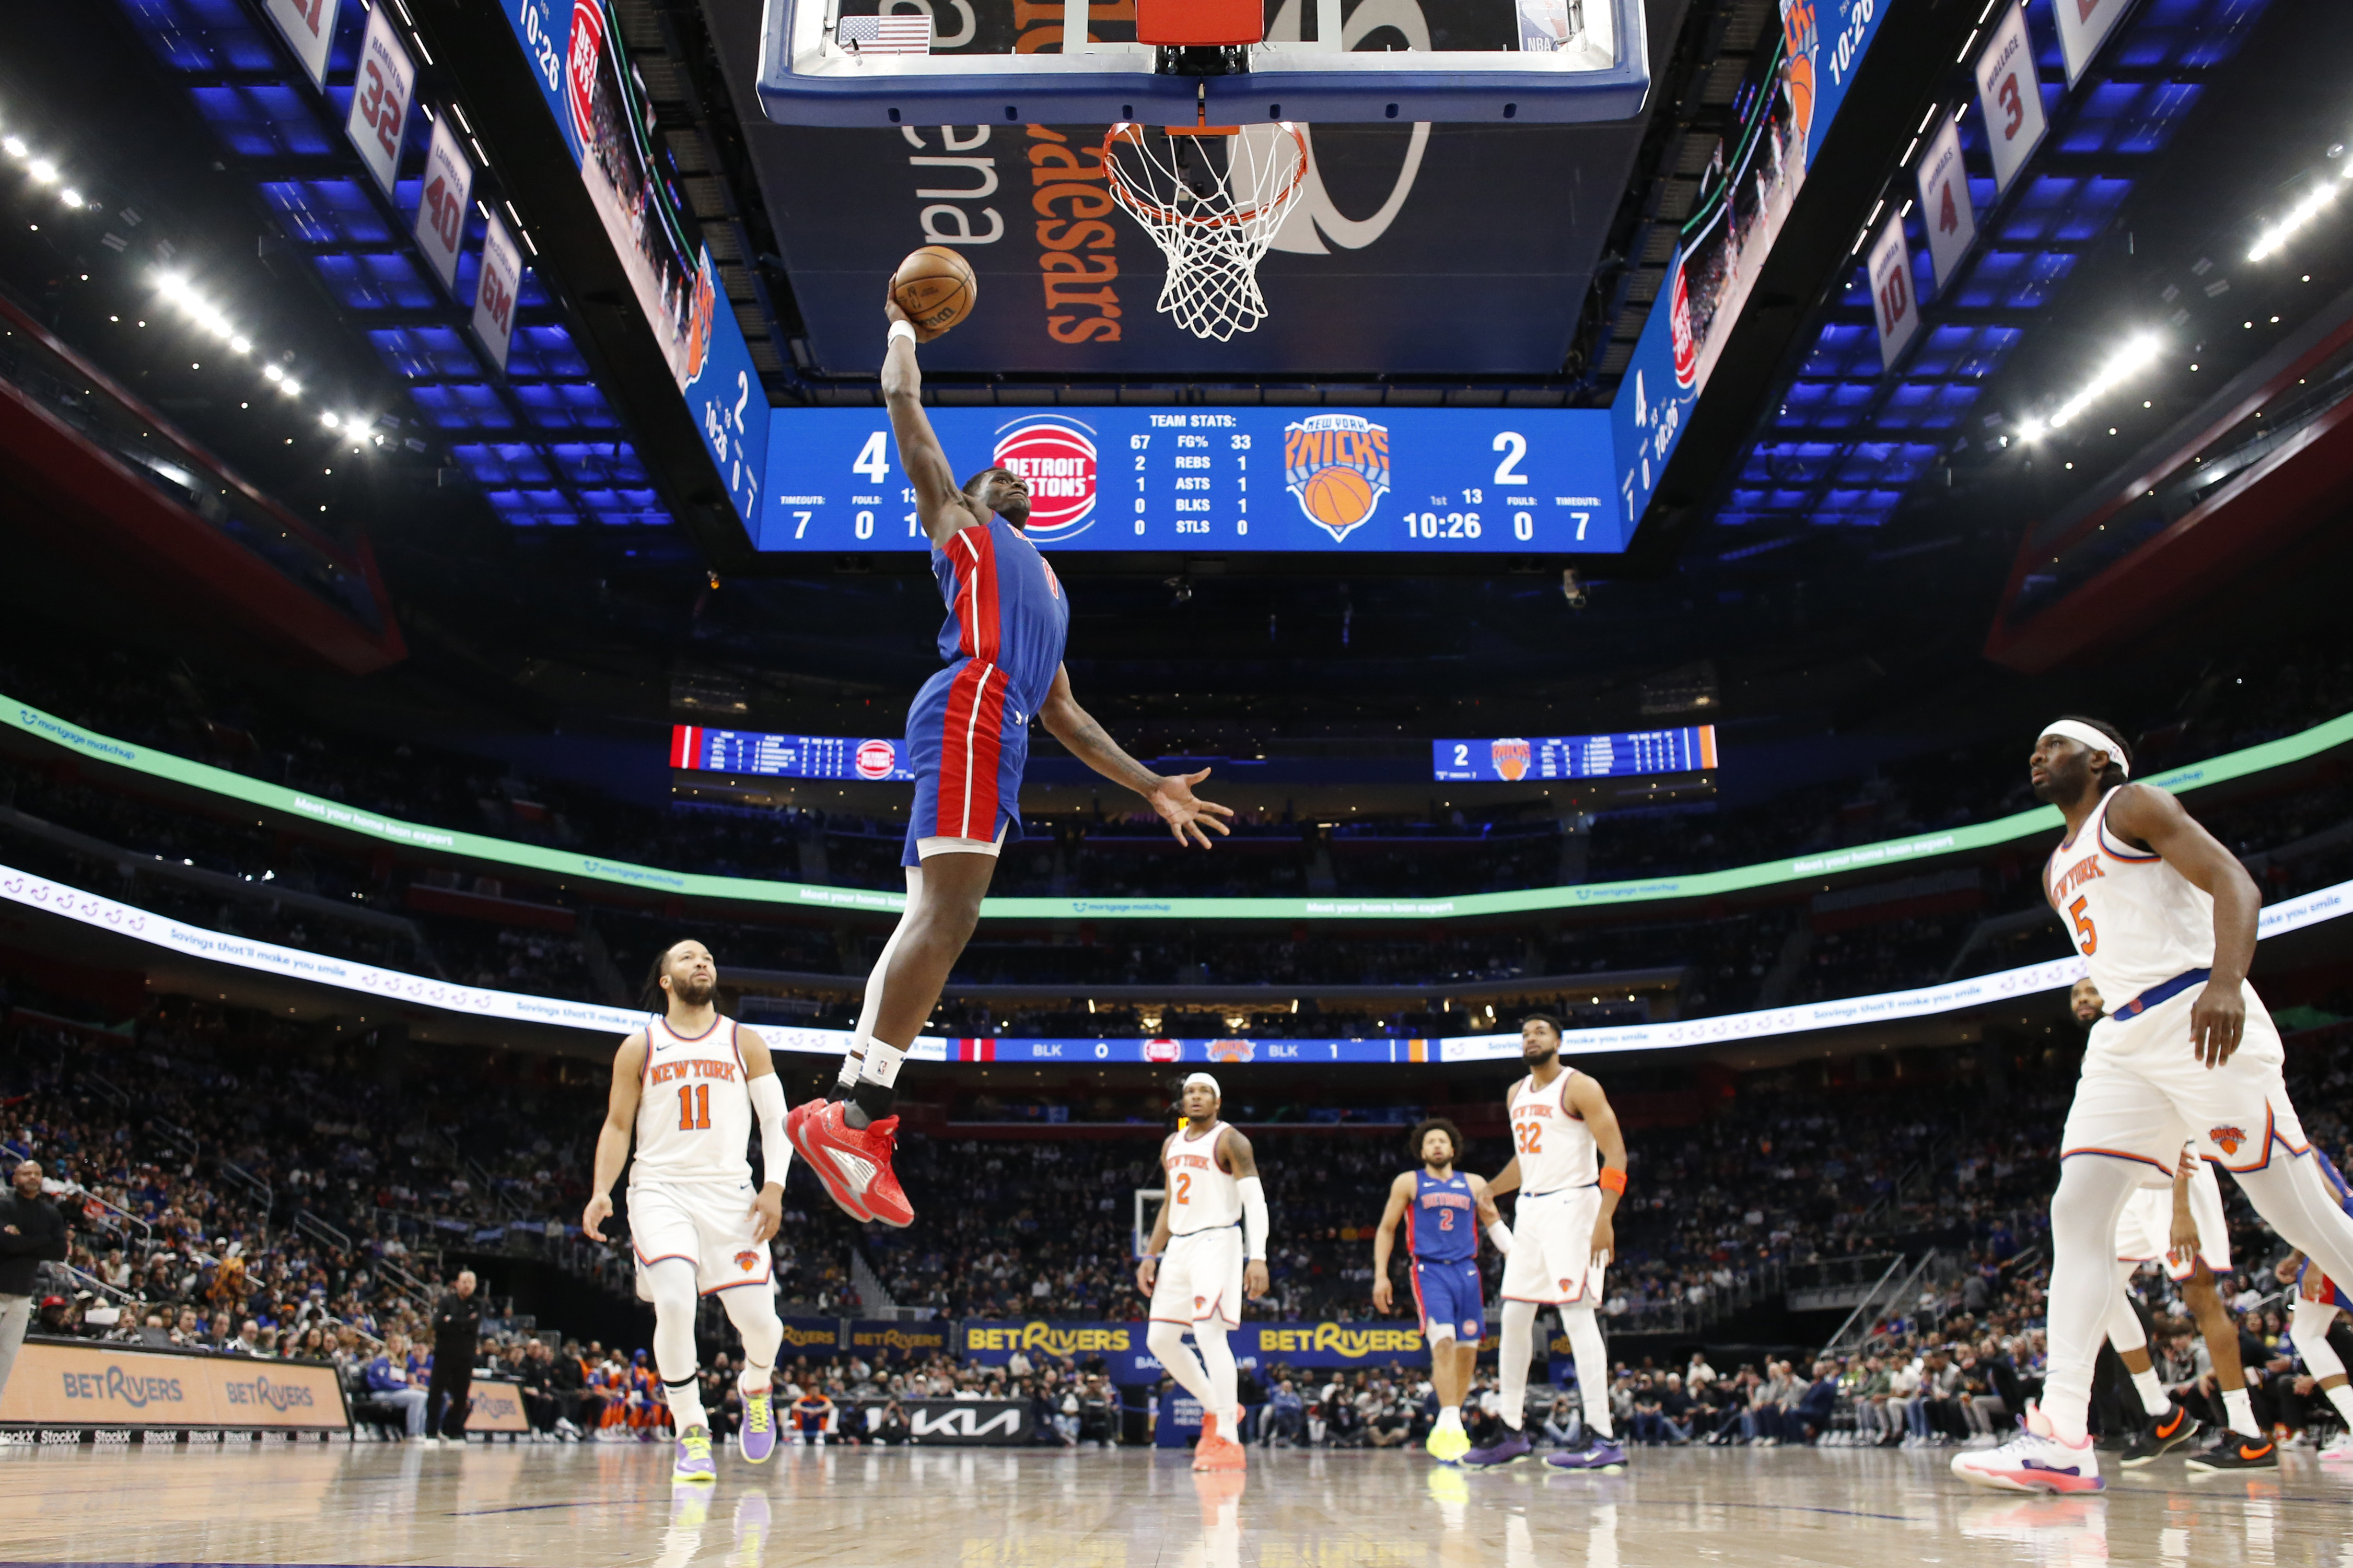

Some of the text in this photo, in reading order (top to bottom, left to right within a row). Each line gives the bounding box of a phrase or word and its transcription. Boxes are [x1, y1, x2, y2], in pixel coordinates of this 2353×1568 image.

[1528, 37, 1552, 51] NBA
[372, 36, 405, 98] HAMILTON
[1987, 34, 2020, 93] WALLACE
[360, 60, 401, 160] 32
[1999, 72, 2024, 140] 3
[426, 174, 461, 253] 40
[1940, 178, 1959, 236] 4
[1026, 123, 1145, 343] aesars
[1881, 265, 1907, 337] 10
[1149, 414, 1237, 427] TEAM STATS:
[1306, 419, 1366, 431] NEW YORK
[1131, 434, 1251, 449] 67 FG% 33
[1285, 430, 1389, 470] KNICKS
[853, 431, 890, 484] 4
[1004, 458, 1086, 476] DETROIT
[1135, 455, 1246, 471] 2 REBS 1
[1493, 431, 1528, 485] 2
[1136, 476, 1246, 492] 1 ASTS 1
[1462, 488, 1483, 504] 13
[781, 496, 826, 505] TIMEOUTS:
[852, 496, 882, 505] FOULS:
[1135, 498, 1247, 513] 0 BLKS 1
[1507, 496, 1537, 506] FOULS:
[1555, 497, 1601, 506] TIMEOUTS:
[793, 511, 812, 539] 7
[855, 510, 874, 540] 0
[1135, 519, 1248, 535] 0 STLS 0
[1403, 512, 1482, 539] 10:26
[1514, 511, 1533, 541] 0
[1570, 512, 1590, 541] 7
[38, 718, 135, 760] mortgage matchup
[1454, 744, 1469, 766] 2
[294, 797, 453, 846] Meet your home loan expert
[1793, 859, 1825, 873] Meet
[2068, 853, 2105, 891] YORK
[800, 888, 830, 901] Meet
[2310, 895, 2342, 912] smile
[1306, 902, 1454, 915] Meet your home loan expert
[2068, 894, 2098, 957] 5
[170, 928, 214, 950] Savings
[257, 950, 290, 965] make
[293, 959, 314, 972] you
[317, 961, 347, 977] smile
[1032, 1044, 1062, 1057] BLK
[1094, 1043, 1109, 1059] 0
[1268, 1045, 1298, 1057] BLK
[1330, 1044, 1338, 1059] 1
[650, 1059, 736, 1086] NEW YORK
[678, 1083, 710, 1131] 11
[1516, 1121, 1542, 1154] 32
[1177, 1173, 1191, 1205] 2
[1439, 1208, 1454, 1231] 2
[968, 1321, 1130, 1357] BETRIVERS
[1260, 1322, 1423, 1358] BETRIVERS
[62, 1365, 183, 1408] BETRIVERS
[225, 1375, 314, 1412] BETRIVERS
[40, 1430, 81, 1444] StockX
[94, 1429, 132, 1444] StockX
